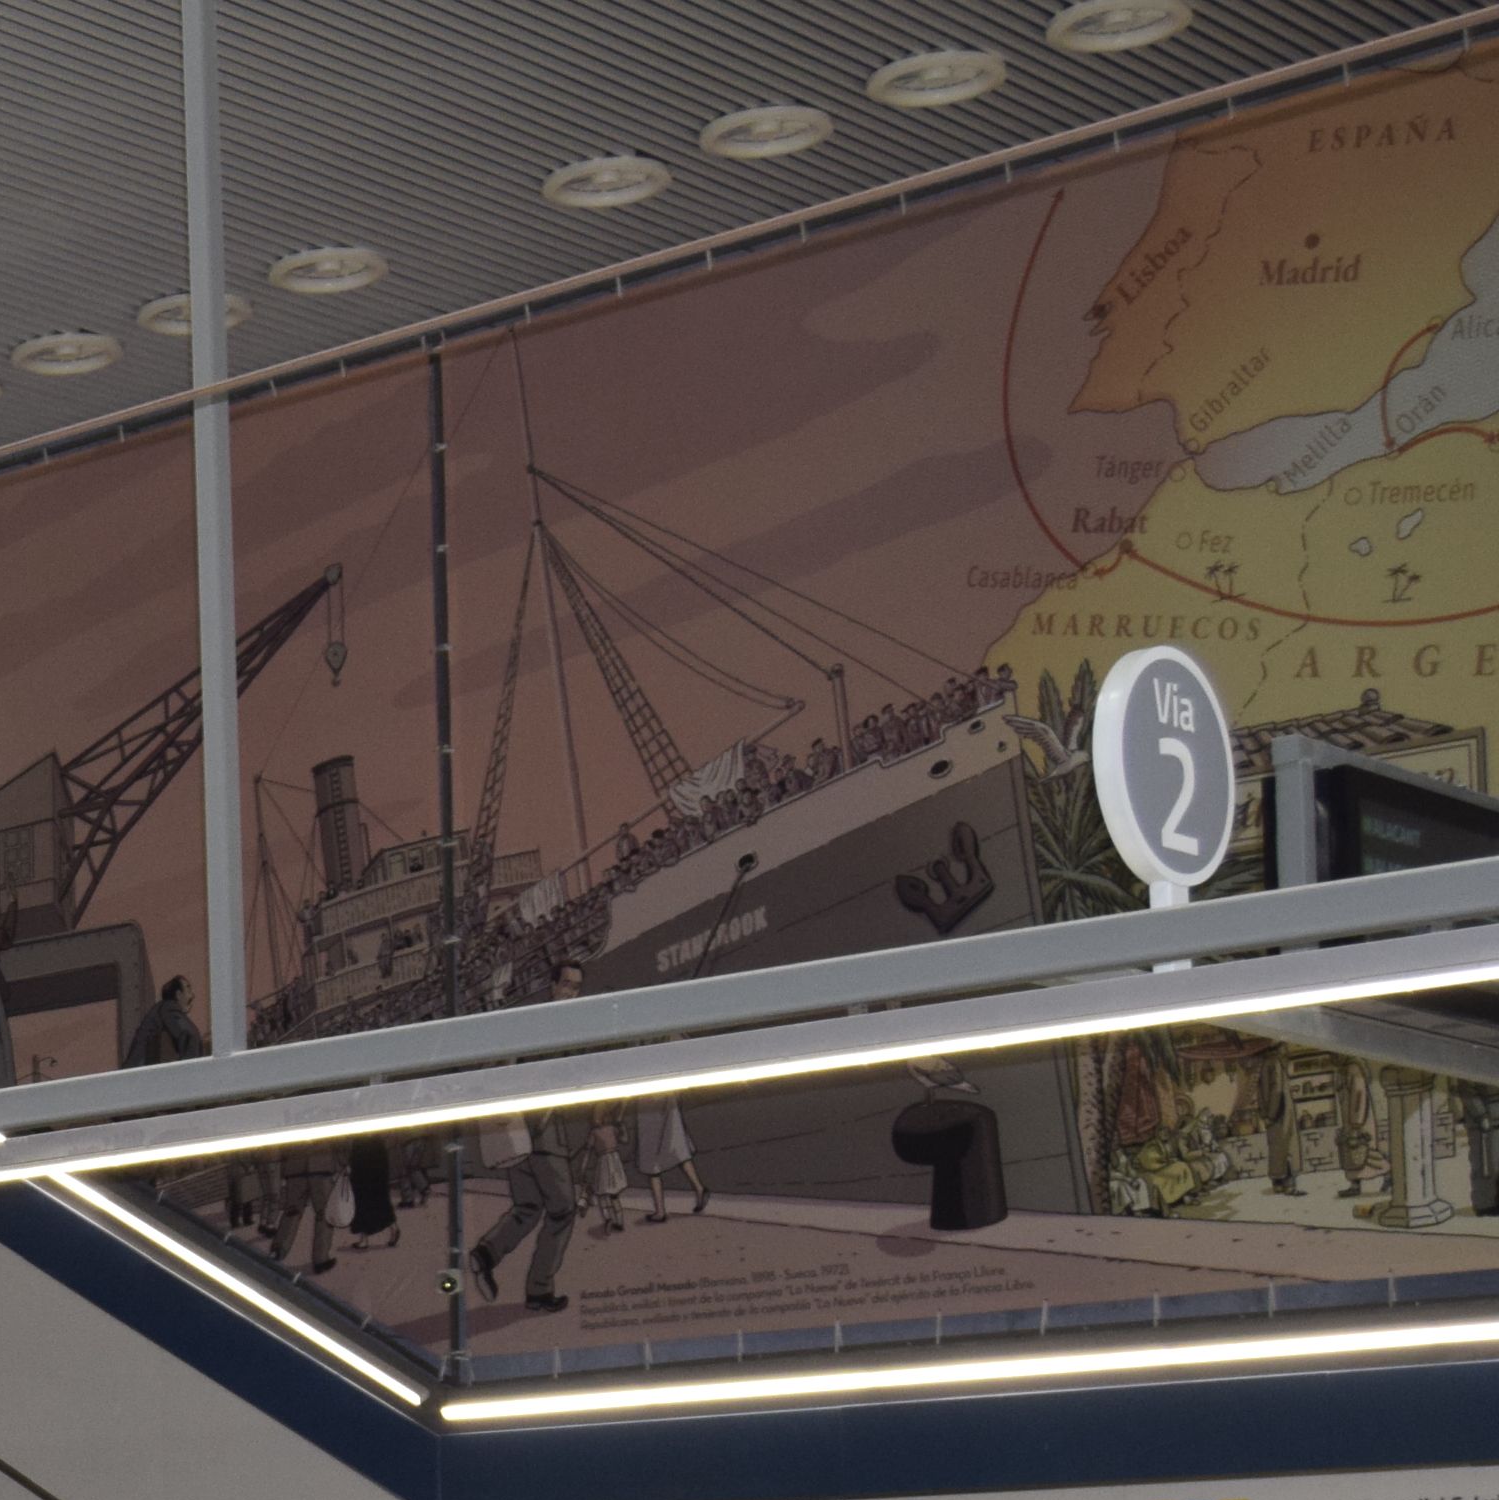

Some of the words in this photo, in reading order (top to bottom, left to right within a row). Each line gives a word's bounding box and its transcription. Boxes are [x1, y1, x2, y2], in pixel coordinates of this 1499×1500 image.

[1308, 114, 1456, 153] ESPAÑA
[1116, 227, 1193, 305] Lisboa
[1259, 254, 1361, 286] Madrid
[1451, 315, 1499, 340] Alic
[1189, 347, 1271, 433] Gibraltar
[1282, 416, 1353, 486] Melilla
[1096, 455, 1164, 485] Tánger
[1369, 476, 1476, 505] Tremecén
[1071, 506, 1149, 535] Rabat
[1199, 530, 1235, 553] Fez
[967, 564, 1078, 590] Casablanca
[1032, 612, 1261, 641] MARRUECOS
[1157, 737, 1200, 857] 2
